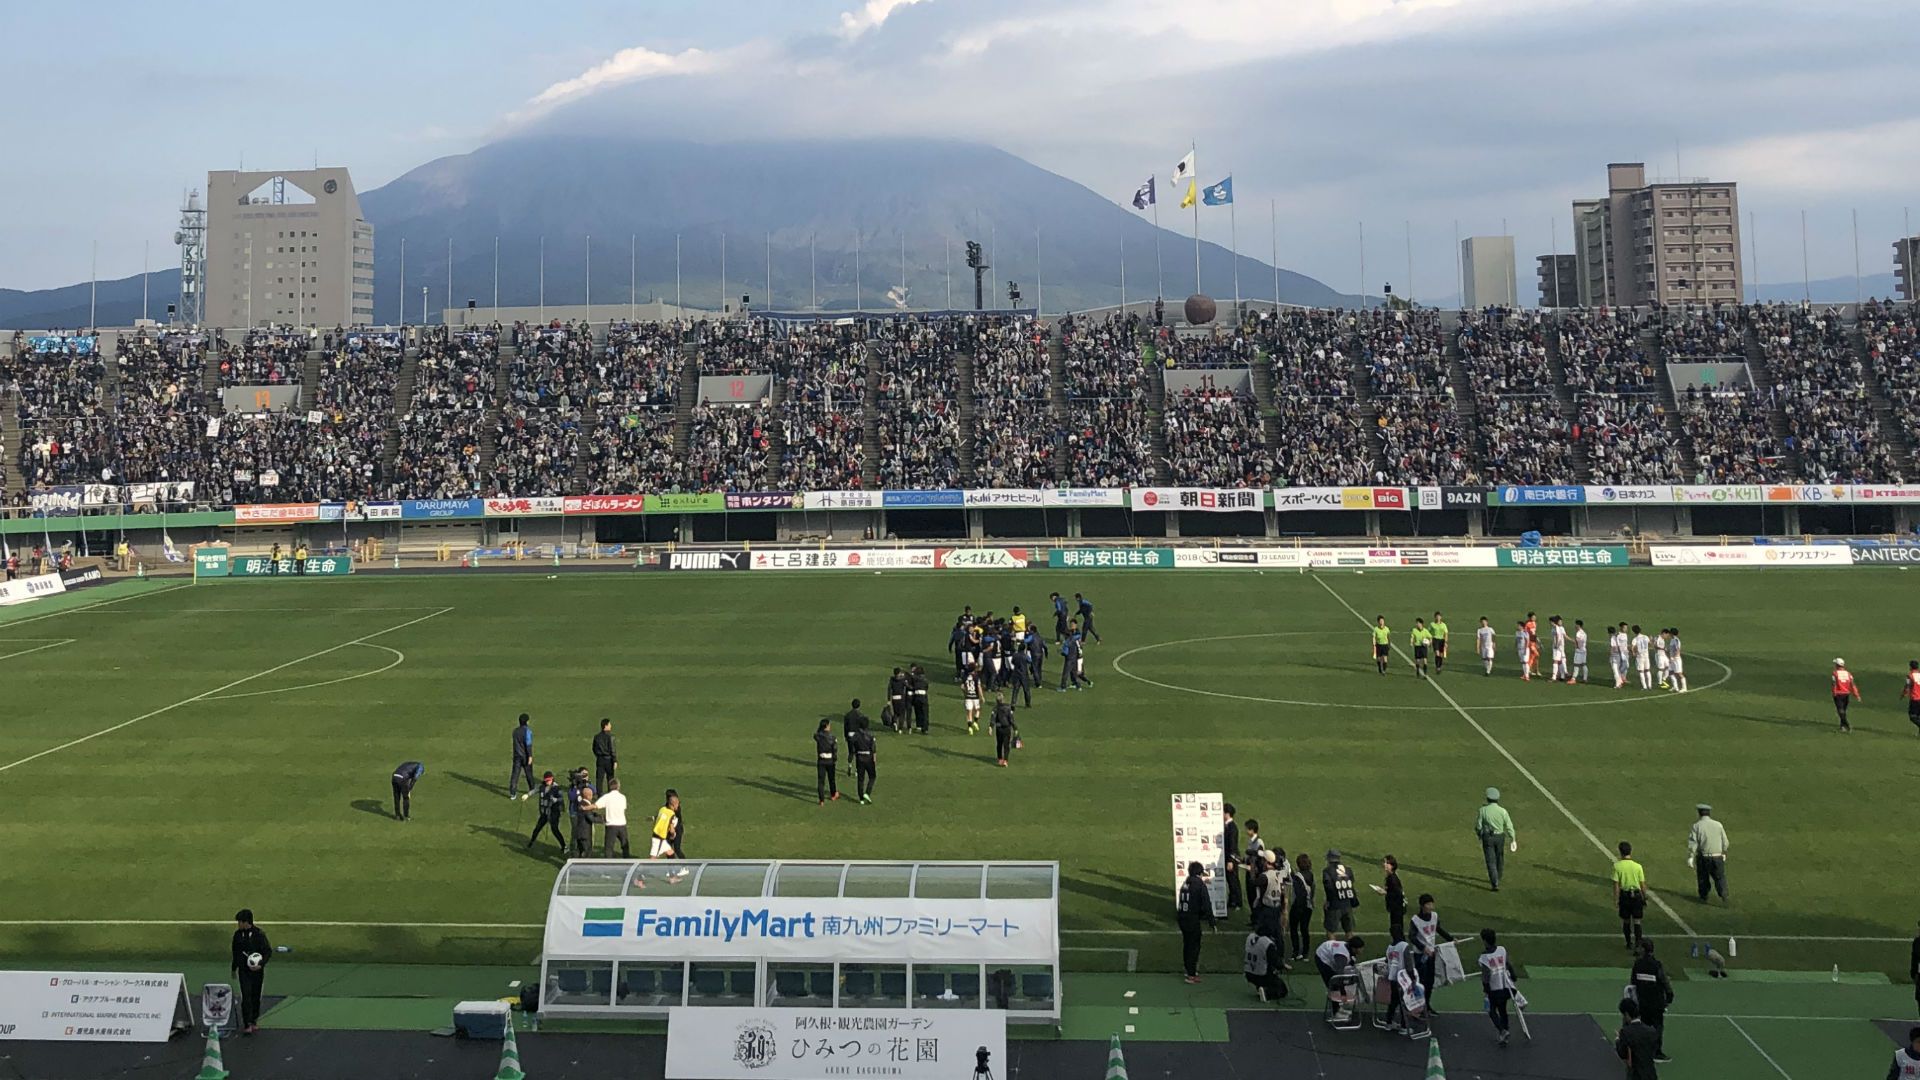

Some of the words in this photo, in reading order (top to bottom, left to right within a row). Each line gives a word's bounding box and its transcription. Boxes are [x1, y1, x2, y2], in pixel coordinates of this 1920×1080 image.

[729, 379, 744, 397] 12
[993, 492, 1041, 503] アサヒビール
[1068, 489, 1107, 497] FamilyMart
[1180, 491, 1255, 508] 朝日新聞
[1281, 492, 1341, 505] スポーツくじ
[1447, 492, 1481, 504] DAZN
[1524, 489, 1578, 500] 南日本銀行
[1619, 490, 1656, 499] 日本ガス
[1792, 487, 1823, 500] KKB
[415, 500, 470, 510] DARUMAYA
[582, 498, 642, 510] ざぼんラーメン
[670, 553, 721, 569] PUMA
[771, 553, 837, 567] 七呂建設
[1063, 550, 1159, 566] 明治安田生命
[1511, 550, 1612, 565] 明治安田生命
[636, 909, 815, 942] FamilyMart
[822, 916, 1019, 937] 南九州ファミリーマート
[791, 1036, 938, 1063] ひみつの花園
